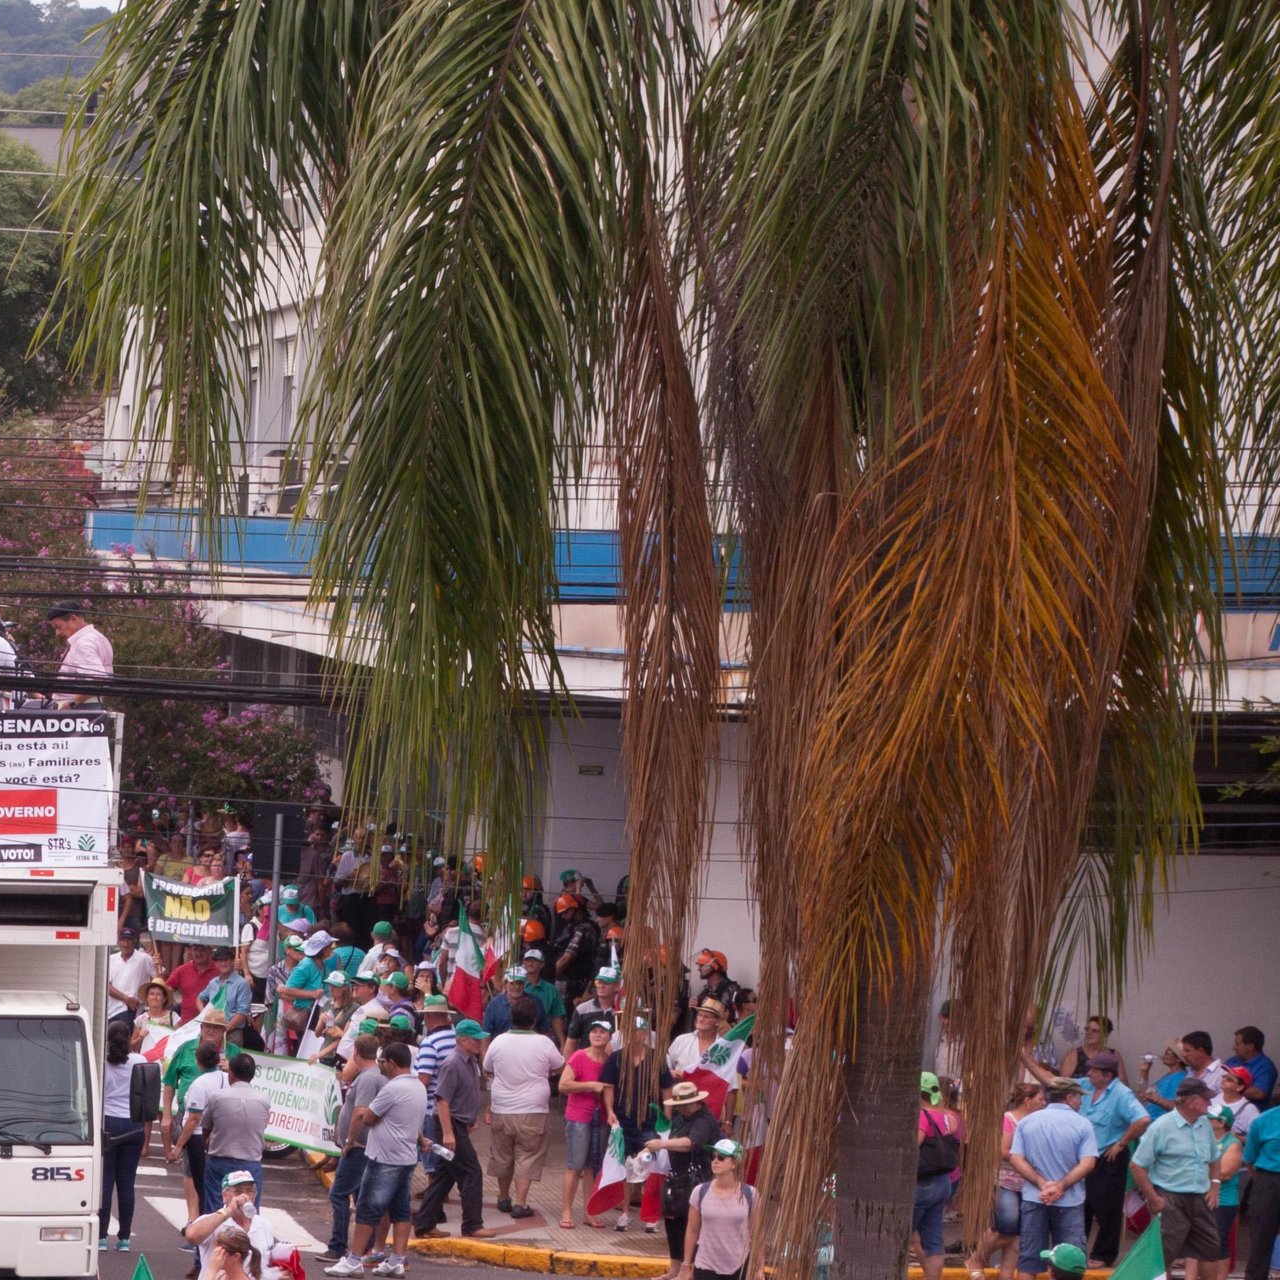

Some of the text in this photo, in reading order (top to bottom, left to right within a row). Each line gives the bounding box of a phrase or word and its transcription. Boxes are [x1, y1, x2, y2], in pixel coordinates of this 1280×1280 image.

[17, 740, 47, 751] está
[28, 757, 102, 768] Familiares
[5, 774, 37, 785] você
[42, 773, 81, 784] está?
[0, 849, 35, 860] VOTO!
[152, 878, 226, 898] PREVIDÊNCIA
[164, 895, 211, 922] NÃO
[155, 919, 230, 939] DEFICITÁRIA
[266, 1066, 310, 1089] CONTRA
